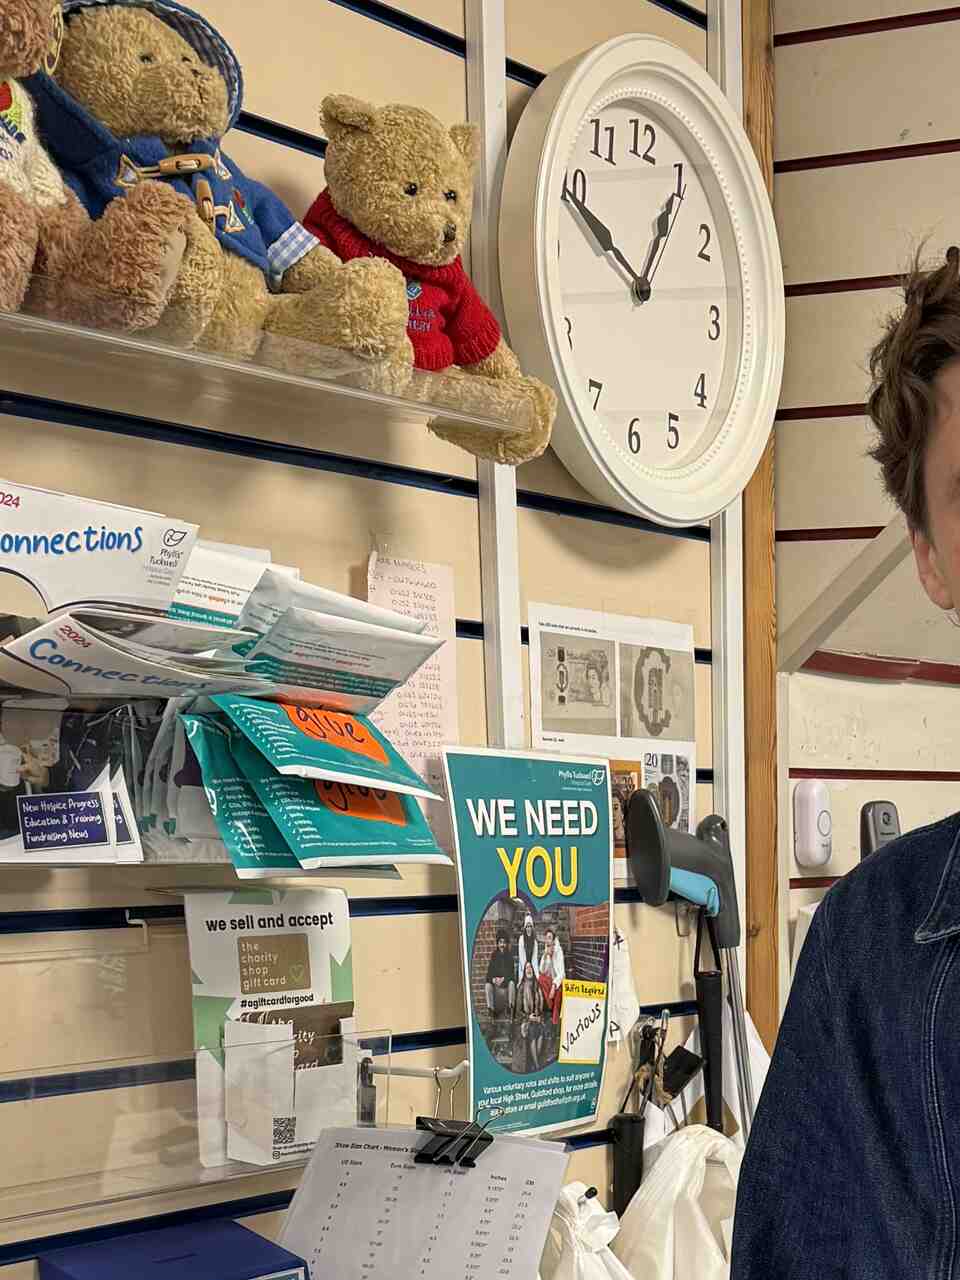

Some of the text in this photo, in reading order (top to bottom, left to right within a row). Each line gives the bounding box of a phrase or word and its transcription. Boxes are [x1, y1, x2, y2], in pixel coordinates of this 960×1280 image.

[590, 119, 656, 165] 11 12
[697, 223, 711, 261] 2
[708, 305, 720, 341] 3
[588, 379, 604, 411] 7
[694, 373, 707, 408] 4
[628, 418, 641, 453] 6
[667, 412, 680, 449] 5
[68, 799, 100, 811] Progress
[466, 799, 598, 836] WE NEED
[24, 816, 61, 828] Education
[62, 815, 69, 826] &
[26, 829, 89, 843] Fundraising News
[496, 846, 578, 897] YOU
[206, 911, 334, 932] we sell and accept
[241, 953, 279, 965] charity
[242, 942, 259, 951] the
[242, 965, 269, 978] shop
[243, 975, 286, 991] gift card
